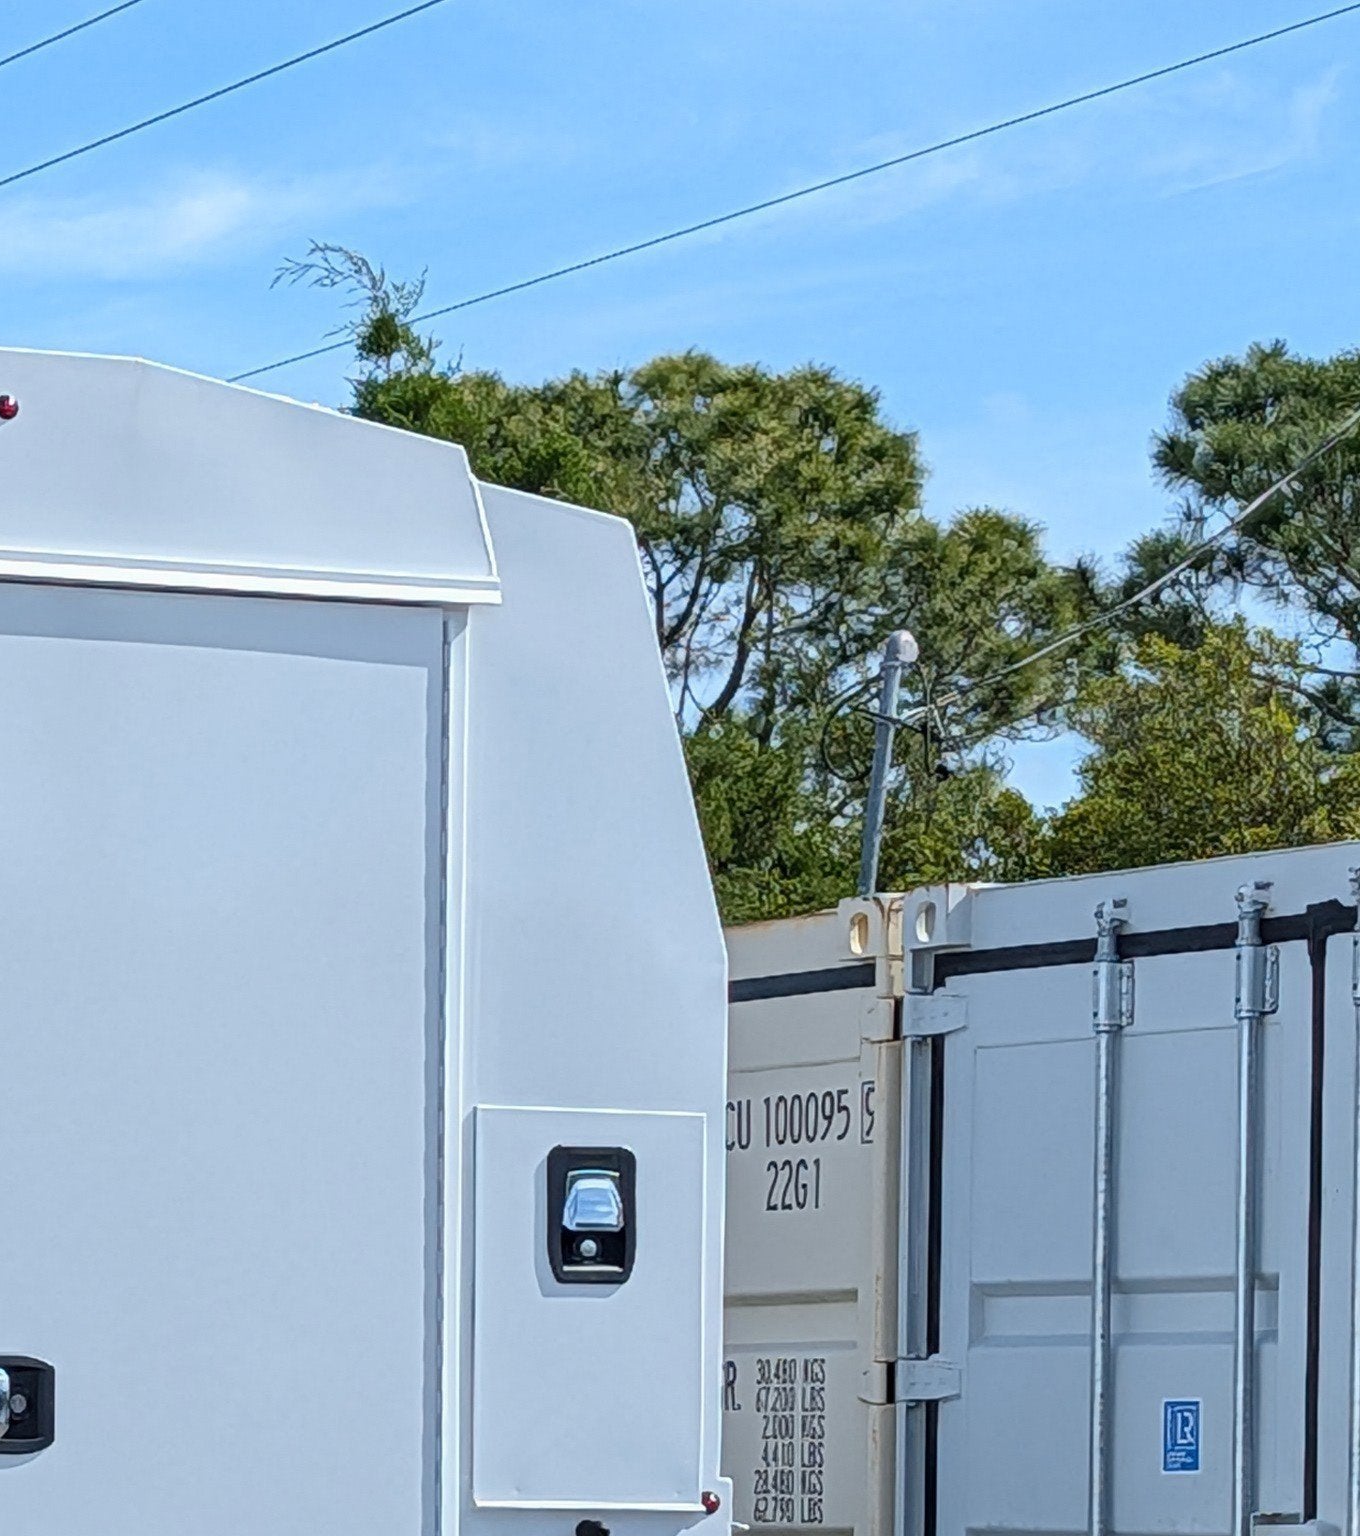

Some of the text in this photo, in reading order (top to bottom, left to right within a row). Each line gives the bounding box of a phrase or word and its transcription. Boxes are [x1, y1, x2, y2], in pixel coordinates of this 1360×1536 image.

[763, 1088, 851, 1148] 100095
[765, 1157, 821, 1212] 22G1
[801, 1441, 825, 1468] LBS
